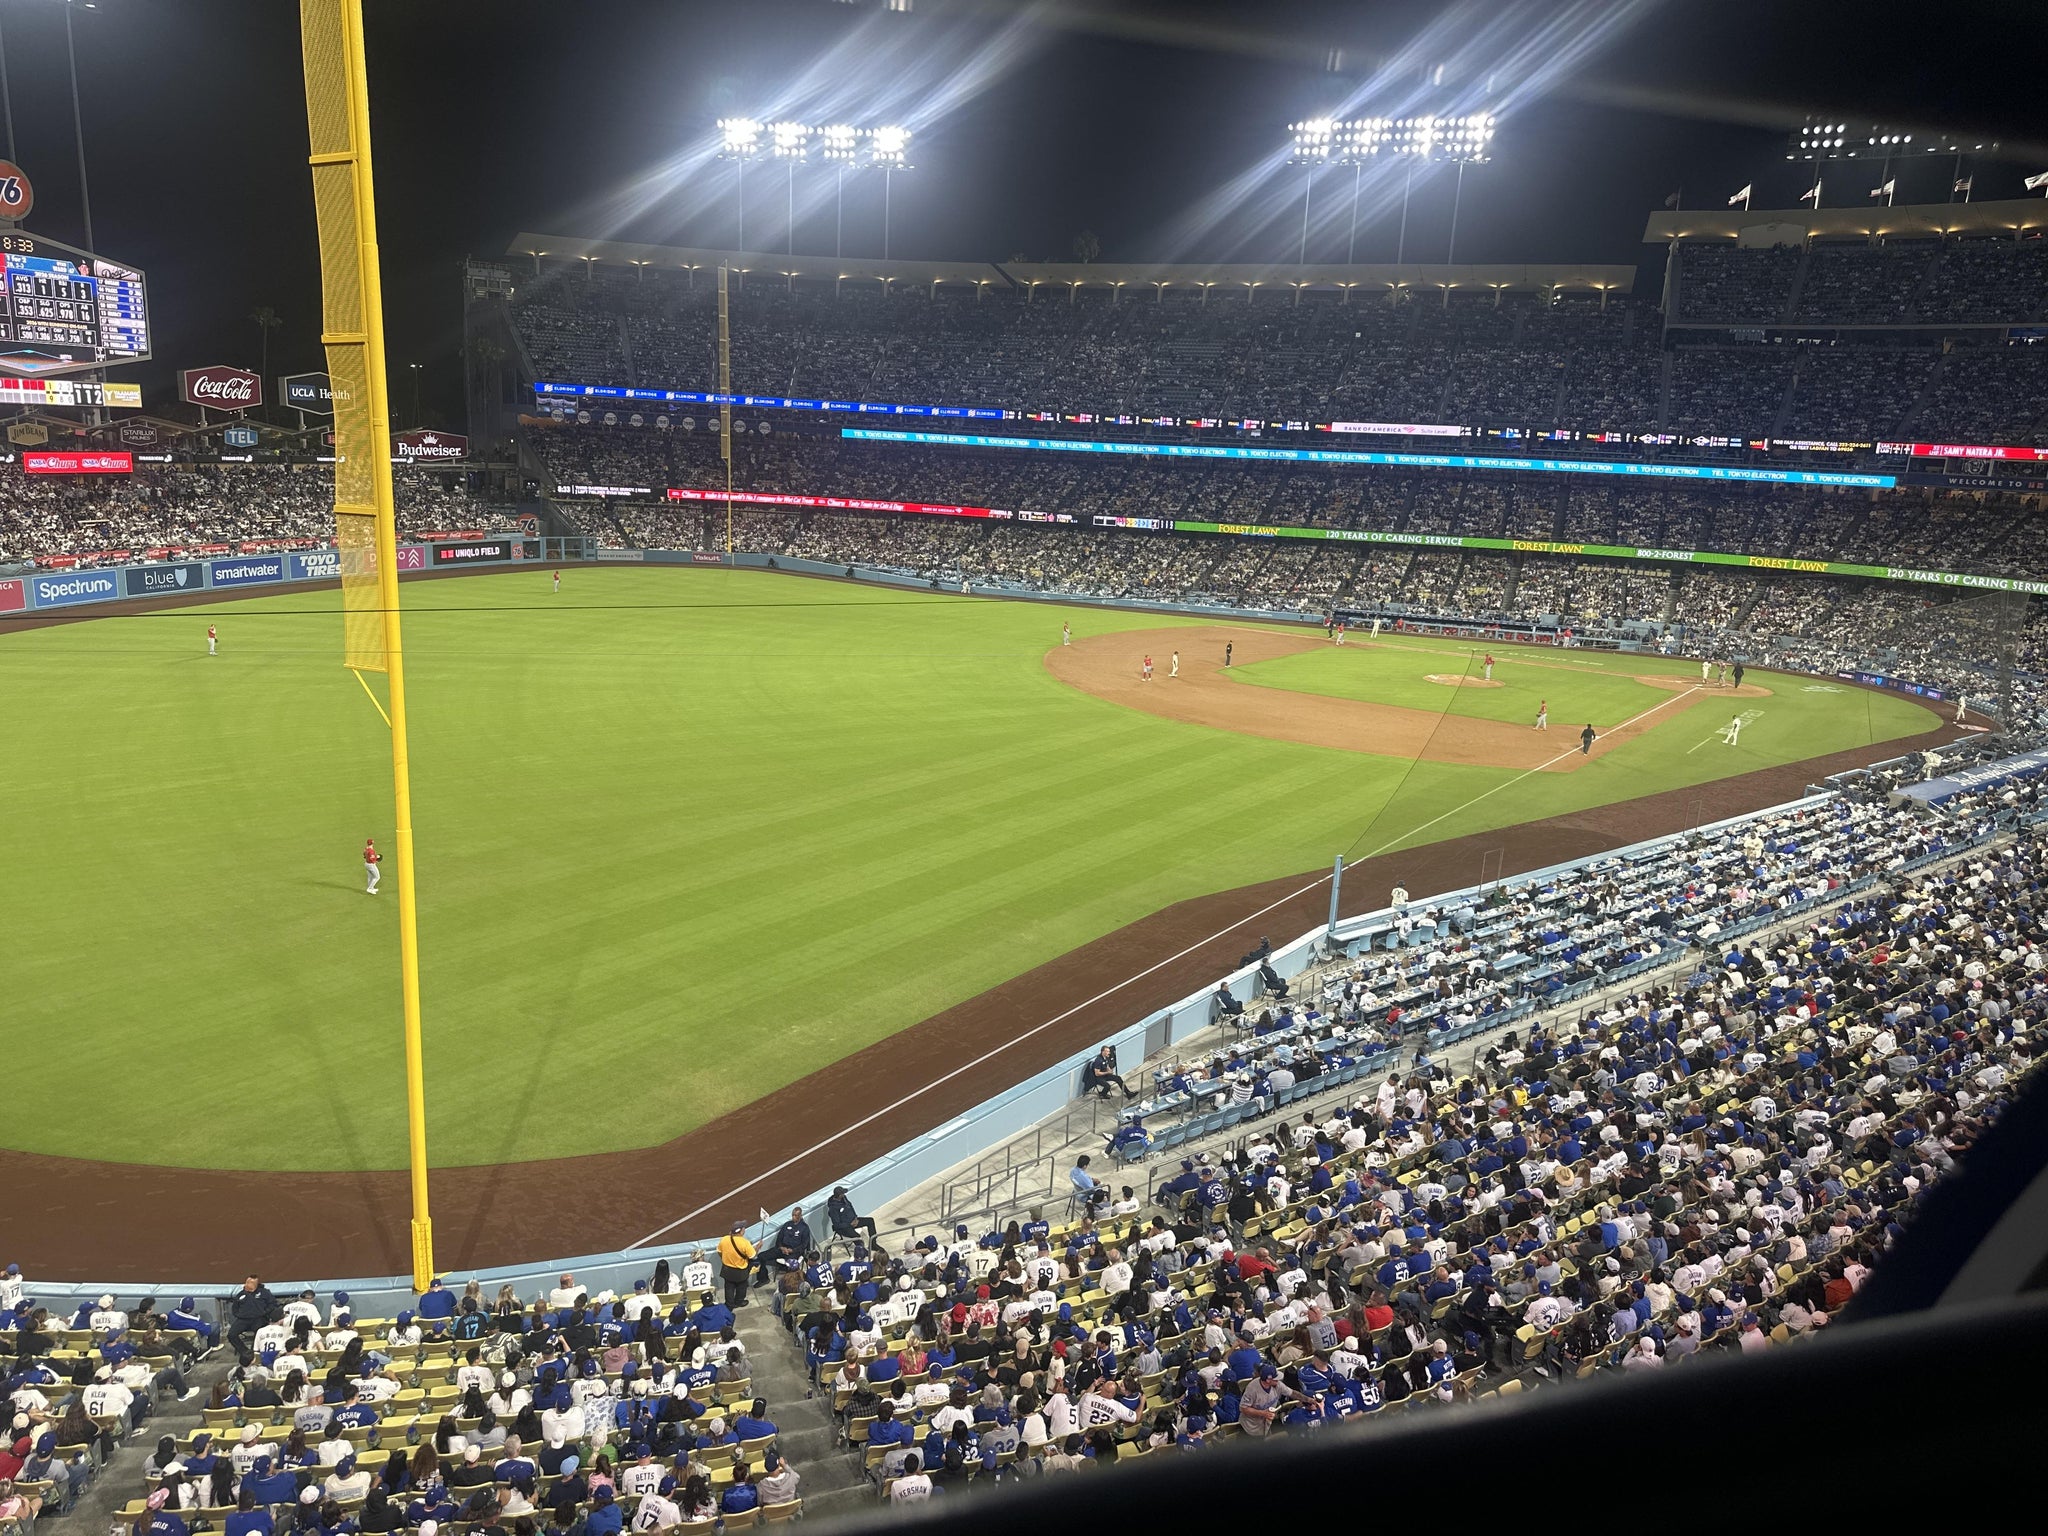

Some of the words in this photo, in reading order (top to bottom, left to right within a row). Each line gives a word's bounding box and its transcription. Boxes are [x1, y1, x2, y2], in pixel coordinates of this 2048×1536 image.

[3, 236, 34, 253] 8:33
[194, 376, 254, 400] Coca-Cola
[291, 388, 315, 397] UCLA
[319, 388, 350, 400] Health
[12, 427, 26, 440] JIM
[25, 425, 45, 439] BEAM
[1965, 449, 1993, 457] NATERA
[47, 457, 77, 468] Churu
[100, 457, 128, 468] Churu
[1949, 478, 2003, 487] WELCOME
[519, 518, 536, 531] 76
[1218, 524, 1250, 534] FOREST
[1252, 526, 1278, 536] LAWN
[1326, 530, 1339, 539] 120
[1342, 531, 1368, 540] YEARS
[1371, 532, 1382, 541] OF
[1385, 533, 1421, 543] CARING
[1425, 535, 1462, 545] SERVICE
[455, 549, 479, 557] UNIQLO
[481, 547, 500, 556] FIELD
[1512, 540, 1550, 552] FOREST
[1552, 543, 1583, 553] LAWN
[300, 554, 335, 566] TOYO
[694, 554, 721, 562] Yakult
[1637, 549, 1694, 561] 800-2-FOREST
[306, 564, 343, 577] TIRES
[1749, 556, 1788, 569] FOREST
[1792, 559, 1827, 572] LAWN
[216, 564, 278, 580] smartwater
[145, 573, 174, 586] blue
[1887, 569, 1903, 578] 120
[1907, 570, 1940, 582] YEARS
[1944, 574, 1959, 584] OF
[1962, 576, 2008, 589] CARING
[40, 579, 108, 601] Spectrum
[1665, 1155, 1676, 1164] 50
[1770, 1217, 1780, 1228] 17
[976, 1259, 989, 1271] 17
[692, 1273, 707, 1287] 22
[819, 1270, 834, 1287] 50
[1039, 1268, 1053, 1280] 89
[1396, 1271, 1409, 1280] 50
[11, 1287, 19, 1297] 17
[906, 1302, 917, 1317] 17
[465, 1323, 479, 1338] 17
[1322, 1333, 1336, 1347] 50
[264, 1342, 276, 1352] 18
[689, 1371, 711, 1382] KERSHAW
[652, 1382, 669, 1391] BETTS
[91, 1391, 107, 1399] KLEIN
[1361, 1389, 1380, 1406] 50
[89, 1402, 104, 1416] 61
[1090, 1401, 1115, 1415] KERSHAW
[1069, 1409, 1077, 1425] 5
[636, 1472, 655, 1481] BETTS
[636, 1483, 655, 1493] 50
[898, 1486, 927, 1499] KERSHAW
[640, 1513, 660, 1528] 17
